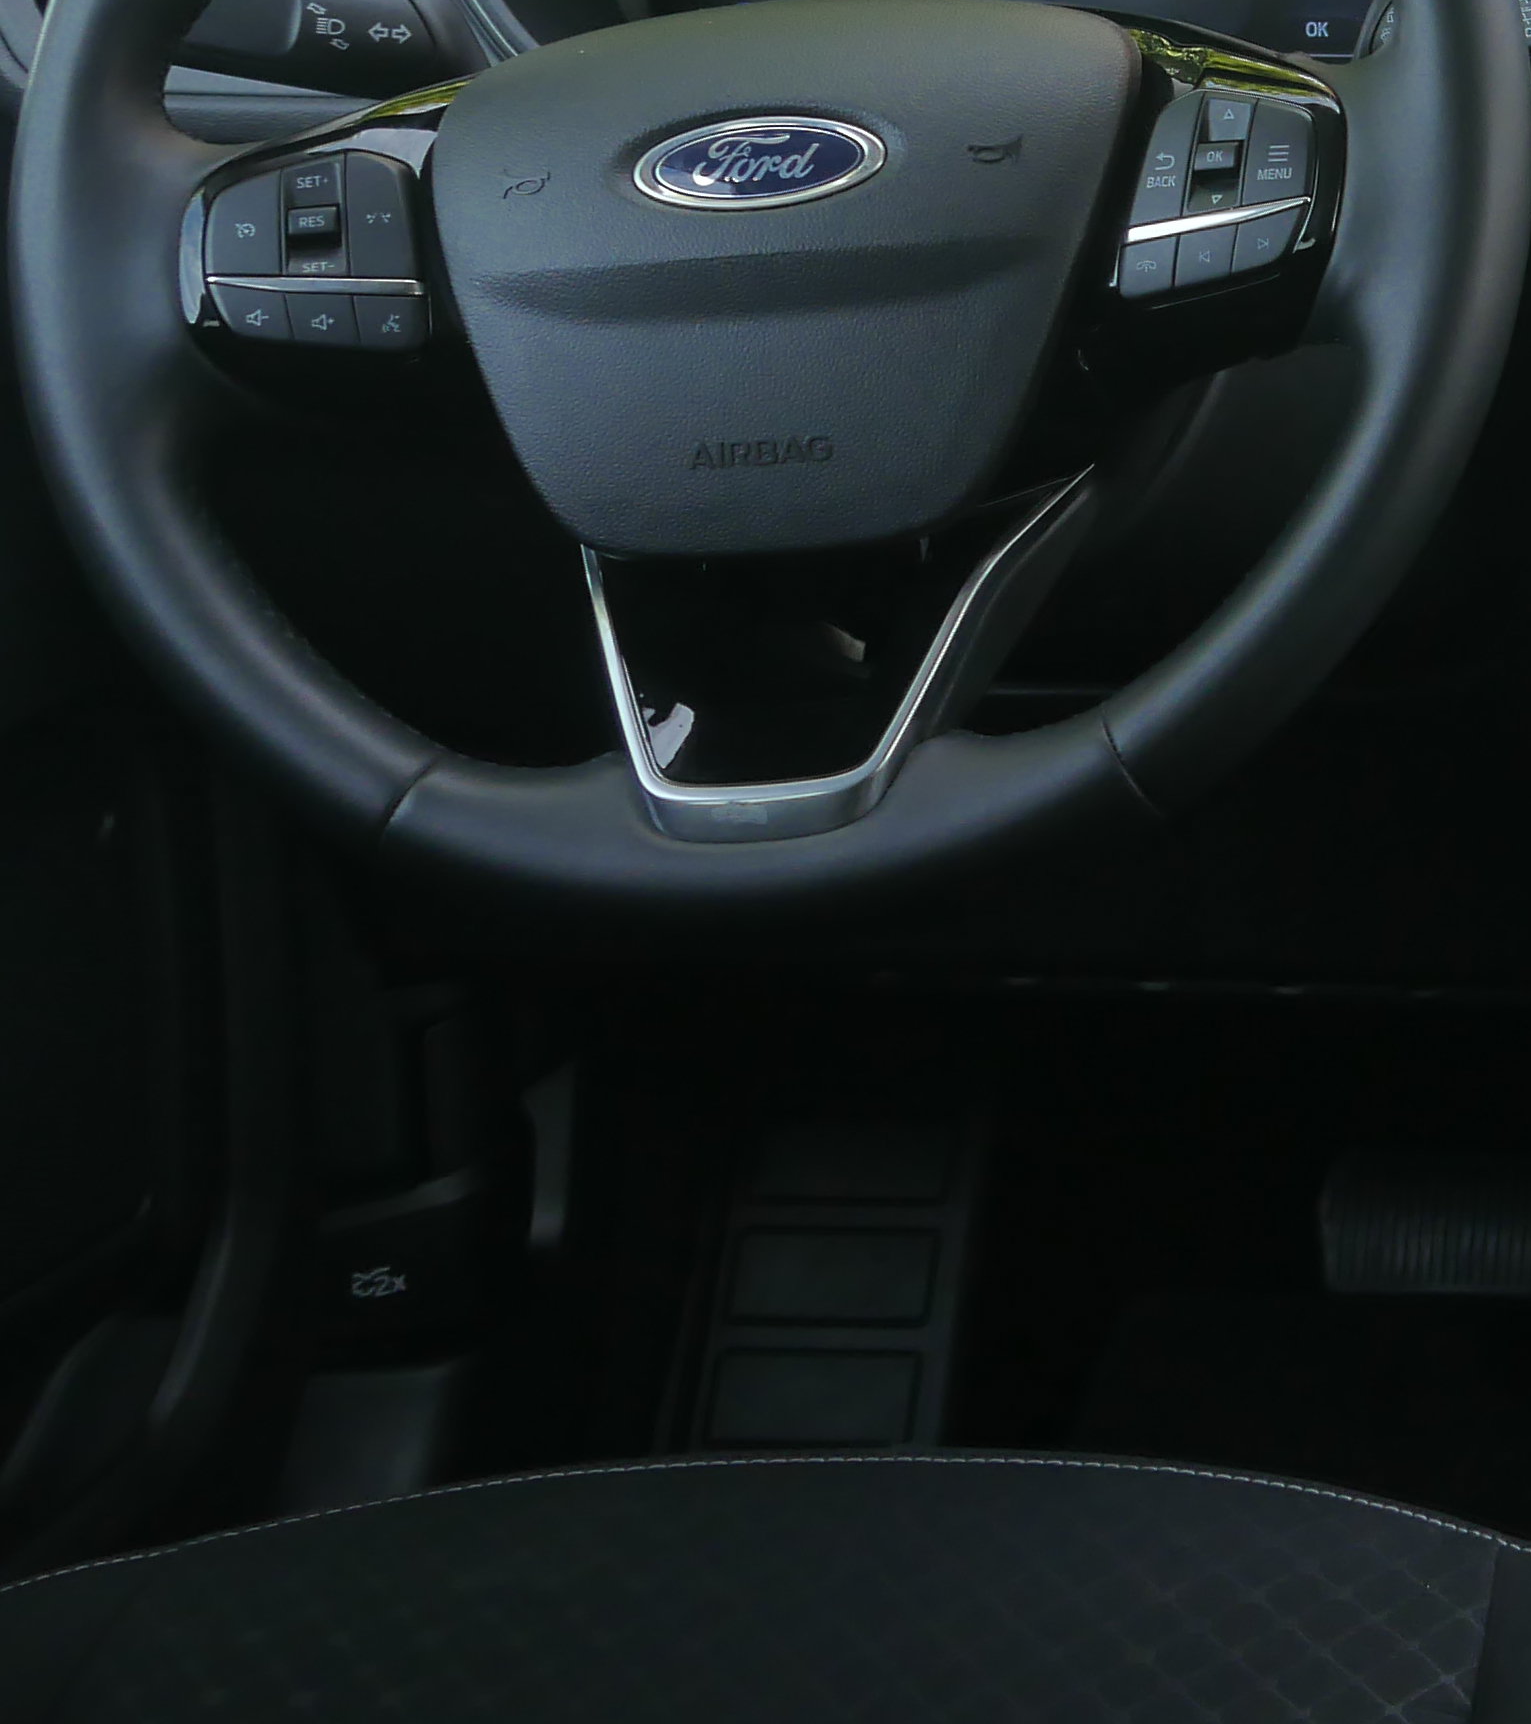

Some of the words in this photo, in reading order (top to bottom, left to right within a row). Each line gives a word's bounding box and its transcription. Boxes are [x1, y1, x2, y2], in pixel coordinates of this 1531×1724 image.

[1305, 21, 1329, 38] OK
[693, 133, 820, 186] Ford
[1206, 151, 1223, 163] OK
[1257, 168, 1292, 181] MENU
[1147, 176, 1176, 188] BACK
[298, 215, 325, 228] RES
[689, 435, 834, 470] AIRBAG
